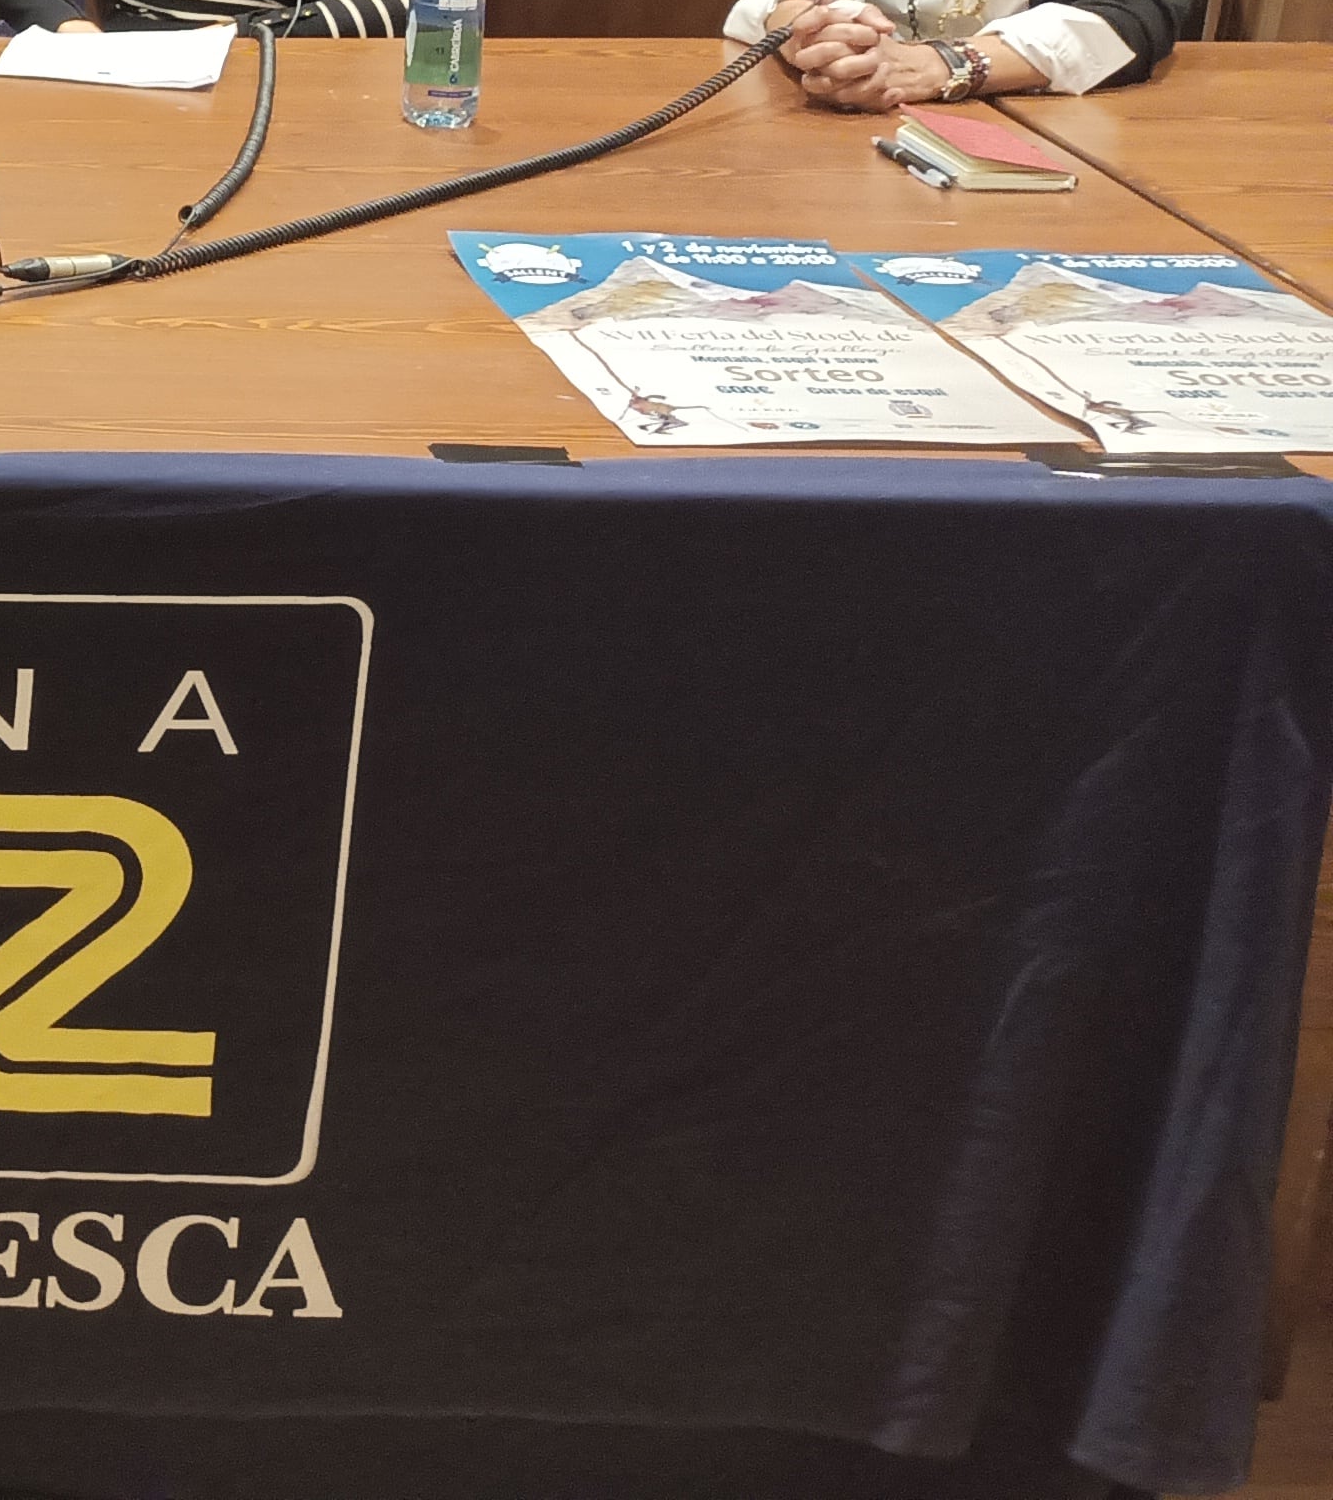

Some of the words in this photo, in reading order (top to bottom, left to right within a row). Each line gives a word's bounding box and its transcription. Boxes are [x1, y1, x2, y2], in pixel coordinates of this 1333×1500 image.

[741, 329, 784, 341] del
[787, 329, 872, 341] Stock
[876, 329, 914, 342] de
[724, 365, 885, 382] Sorteo
[1167, 370, 1332, 386] Sorteo
